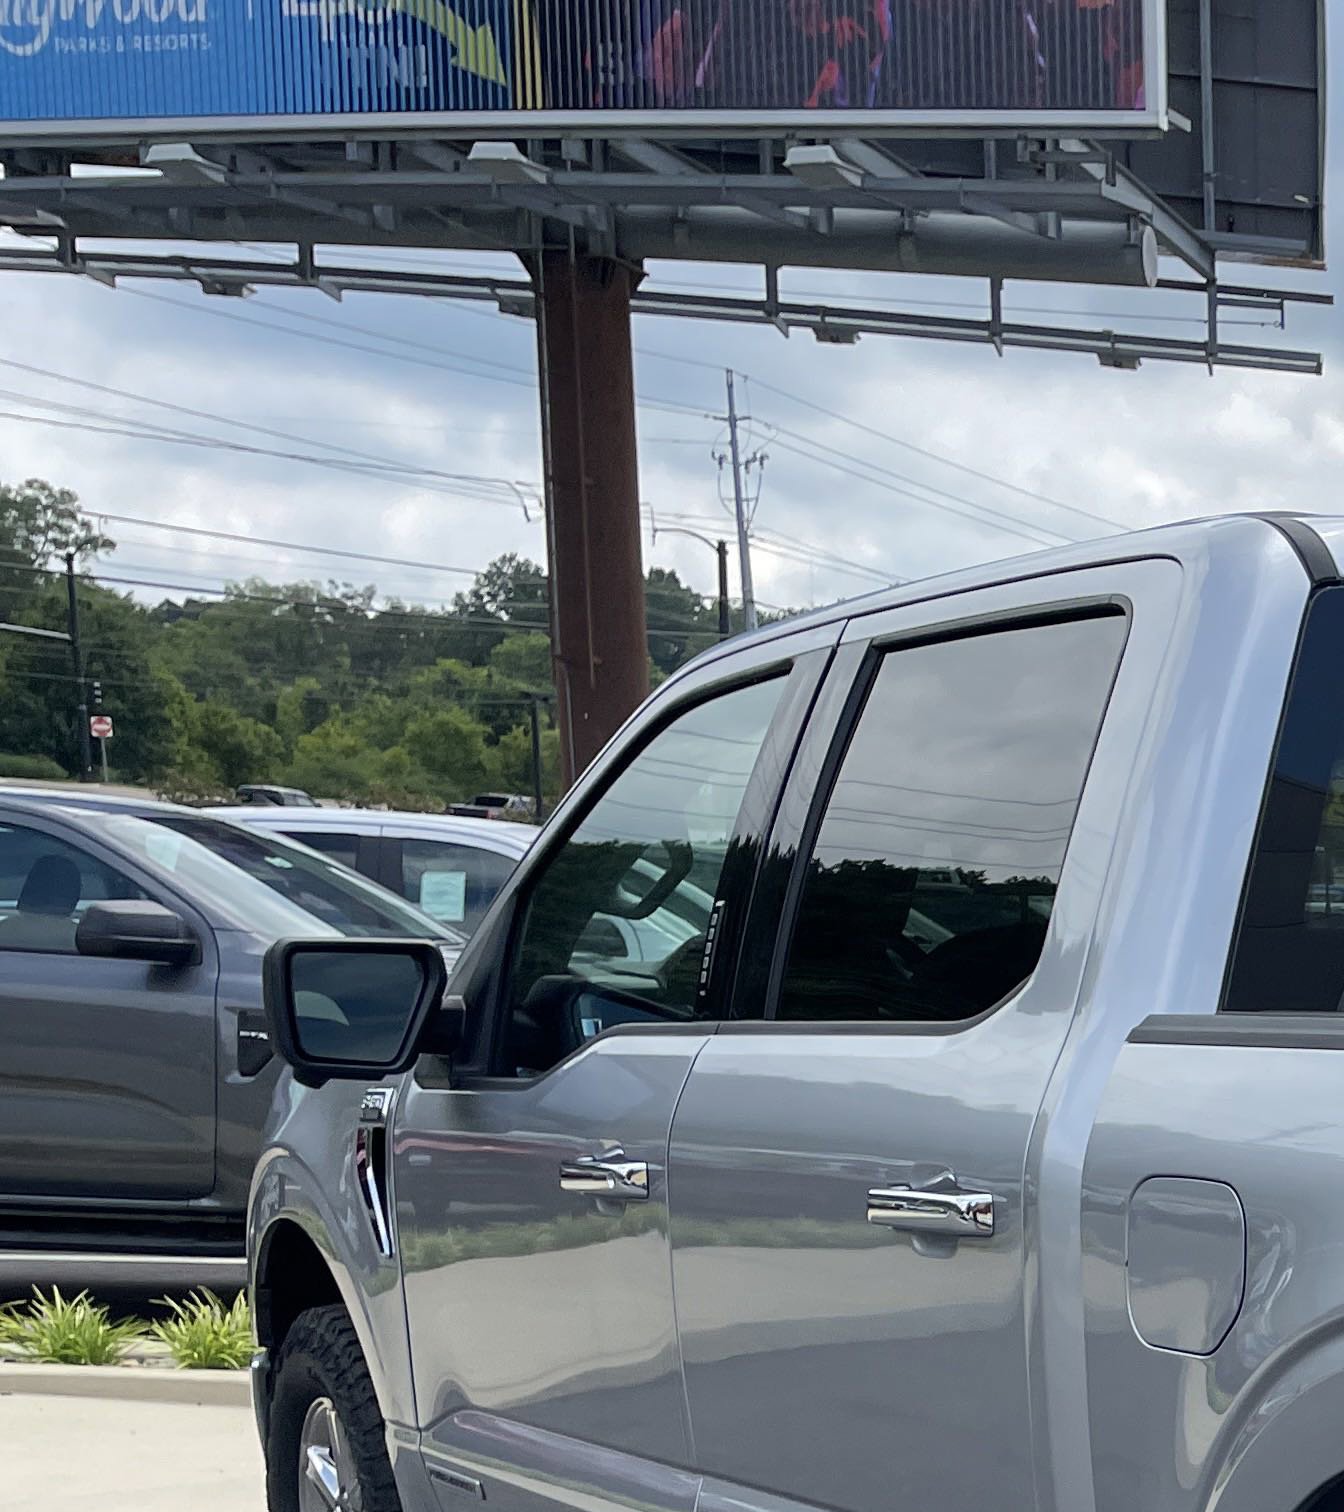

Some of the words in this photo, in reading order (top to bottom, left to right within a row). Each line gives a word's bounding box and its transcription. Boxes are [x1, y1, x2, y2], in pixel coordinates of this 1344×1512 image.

[54, 36, 111, 54] PARKS
[115, 35, 125, 52] &
[134, 33, 212, 52] RESORTS
